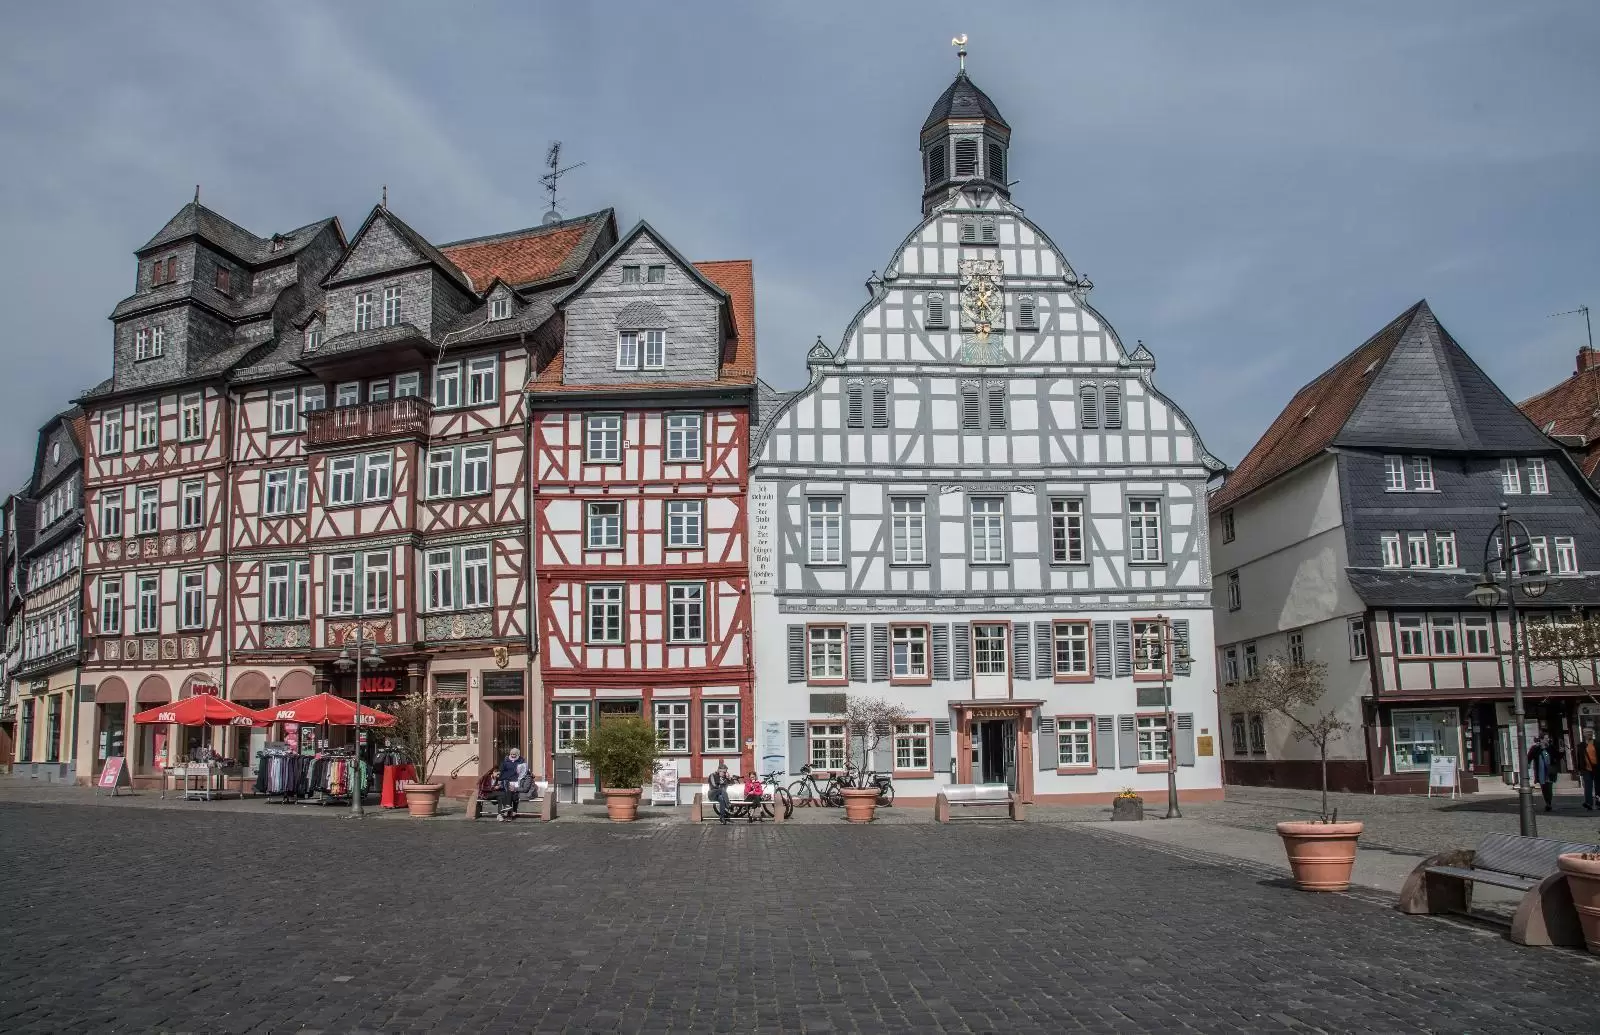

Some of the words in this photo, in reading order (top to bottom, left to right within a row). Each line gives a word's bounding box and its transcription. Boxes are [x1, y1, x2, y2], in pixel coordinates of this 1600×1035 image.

[193, 683, 218, 695] NKD
[360, 677, 396, 692] NKD
[158, 711, 176, 721] NKD
[276, 710, 296, 720] NKD
